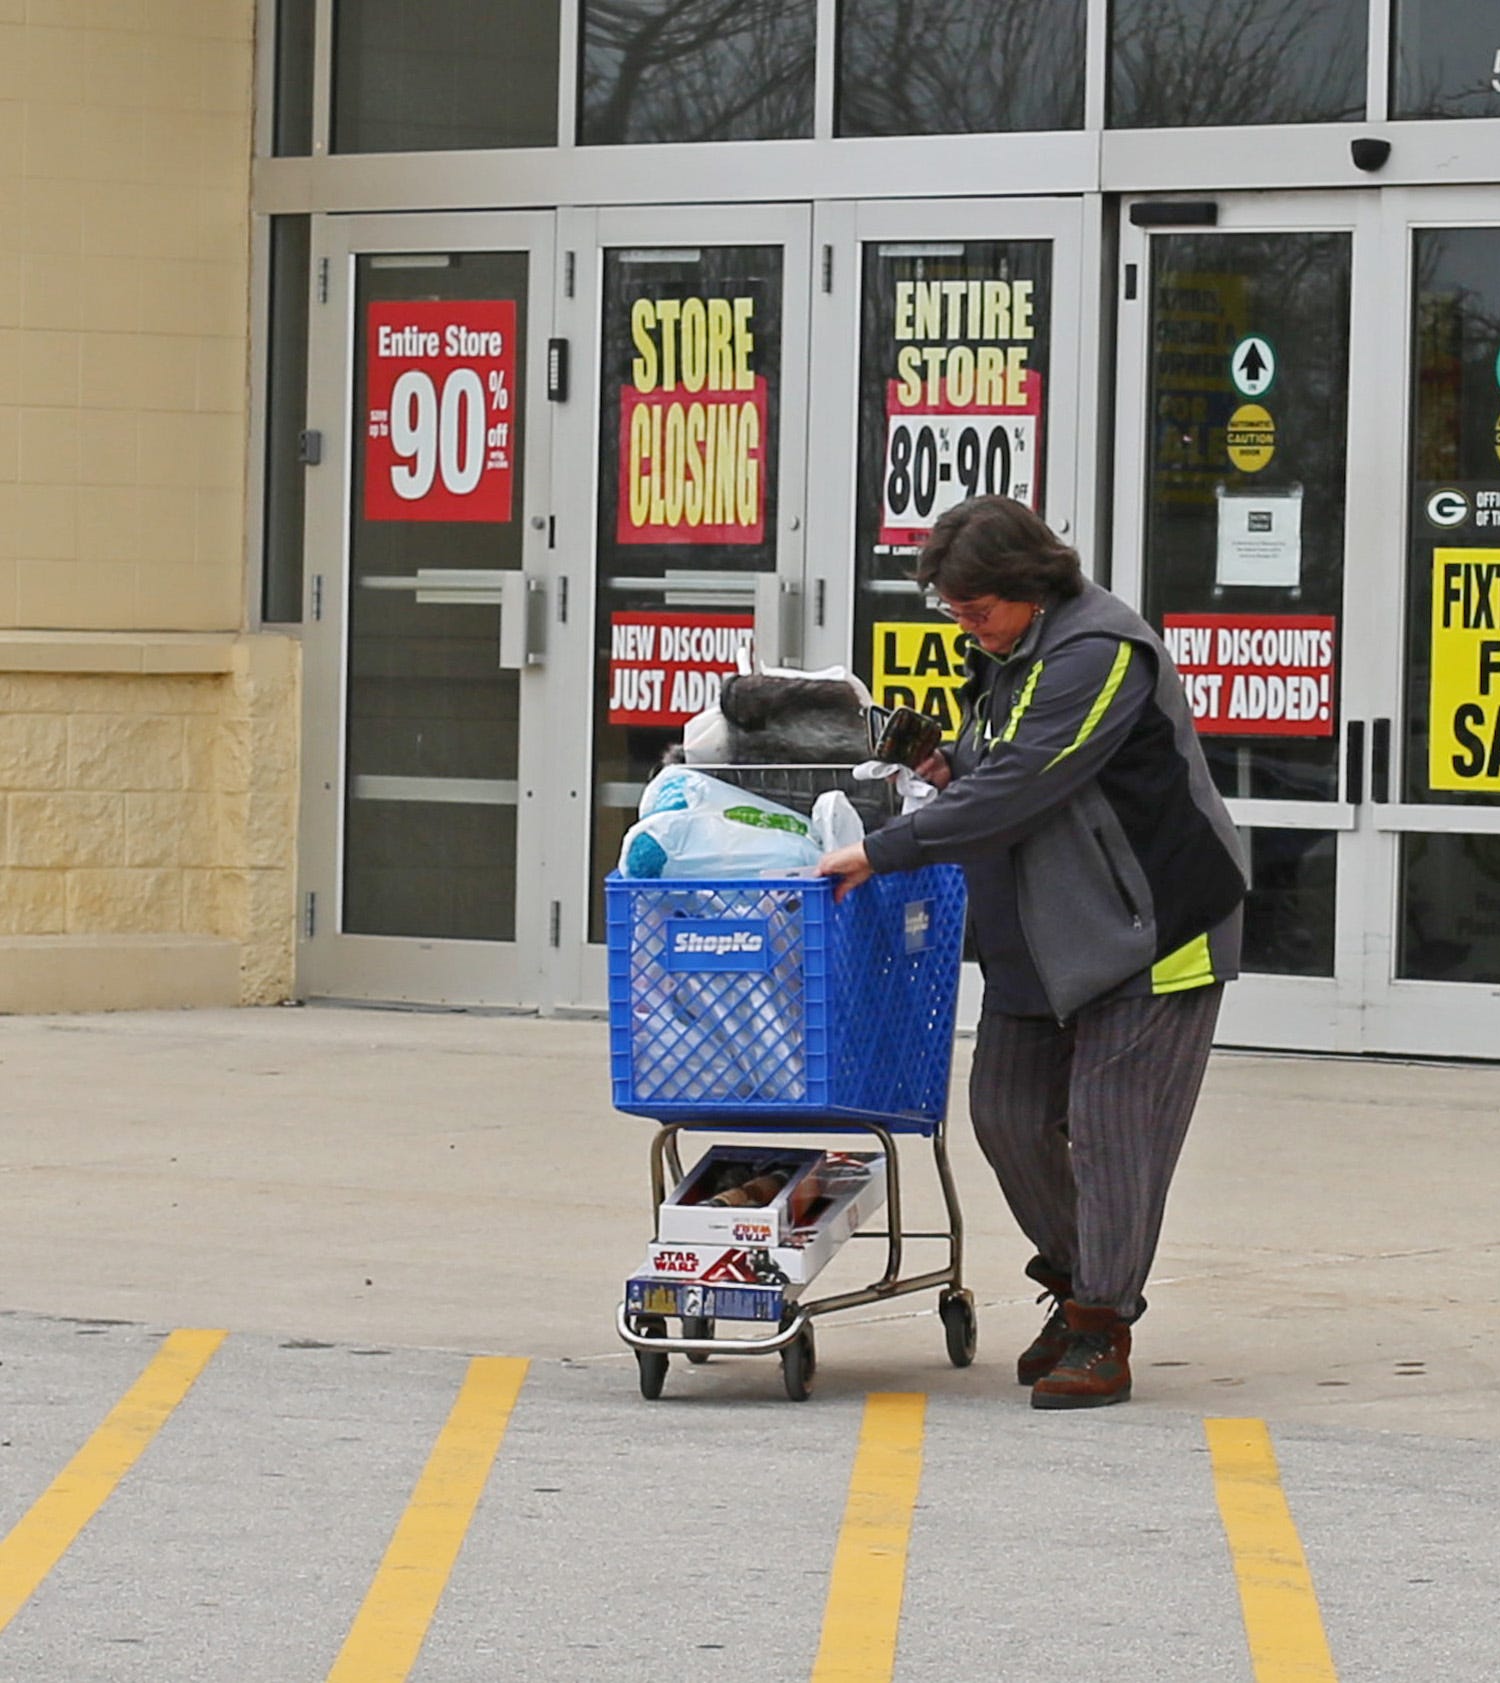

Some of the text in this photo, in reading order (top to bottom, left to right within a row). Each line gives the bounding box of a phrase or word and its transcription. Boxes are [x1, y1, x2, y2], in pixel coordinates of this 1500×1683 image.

[895, 280, 1035, 340] ENTIRE
[378, 325, 502, 357] Entire Store
[632, 298, 755, 392] STORE
[897, 346, 1028, 407] STORE
[487, 423, 508, 447] off
[1227, 433, 1274, 444] CAUTION
[629, 401, 759, 528] CLOSING
[1476, 511, 1489, 526] OF
[612, 625, 656, 661] NEW
[1164, 628, 1332, 667] NEW DISCOUNTS
[609, 669, 665, 712] JUST
[1228, 674, 1329, 720] ADDED!
[674, 932, 763, 954] ShopKo
[654, 1251, 699, 1263] STAR
[654, 1261, 699, 1272] WARS
